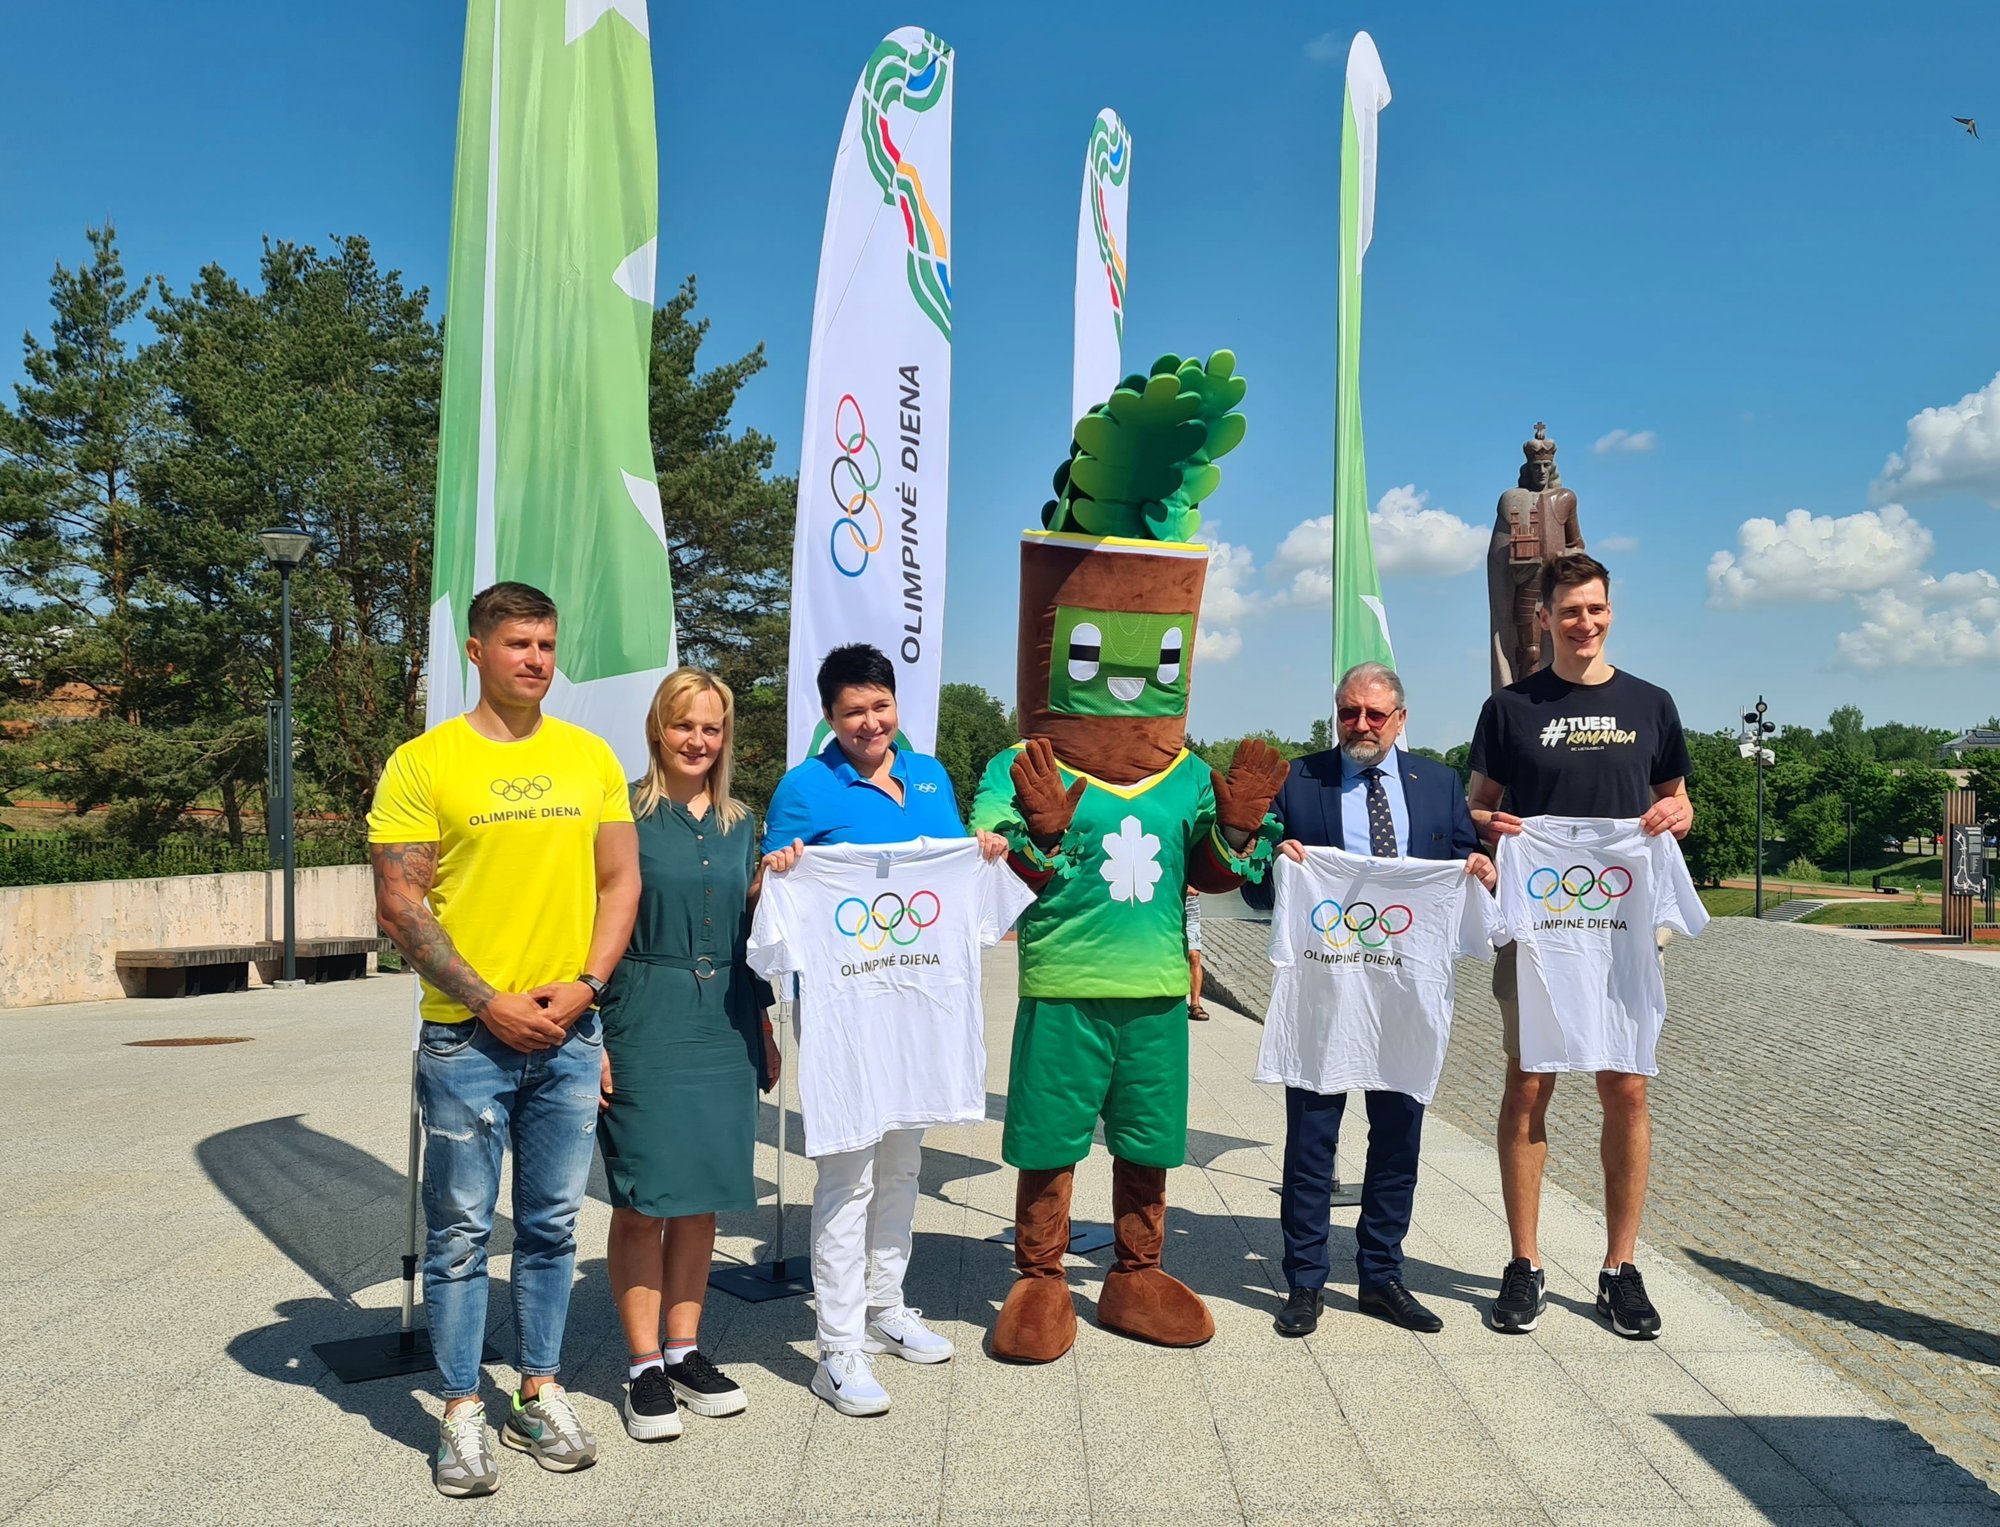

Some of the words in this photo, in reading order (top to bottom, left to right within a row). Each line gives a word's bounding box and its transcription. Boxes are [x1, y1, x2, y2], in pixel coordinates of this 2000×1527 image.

[898, 365, 920, 473] DIENA
[895, 482, 922, 664] OLIMPINĖ
[1566, 730, 1637, 745] KOMANDA
[469, 806, 537, 826] OLIMPINĖ
[541, 806, 581, 818] DIENA
[1533, 916, 1584, 931] LIMPINĖ
[1587, 918, 1628, 931] DIENA
[900, 953, 940, 966] DIENA
[1303, 949, 1361, 965] OLIMPINĖ
[1364, 953, 1403, 968] DIENA
